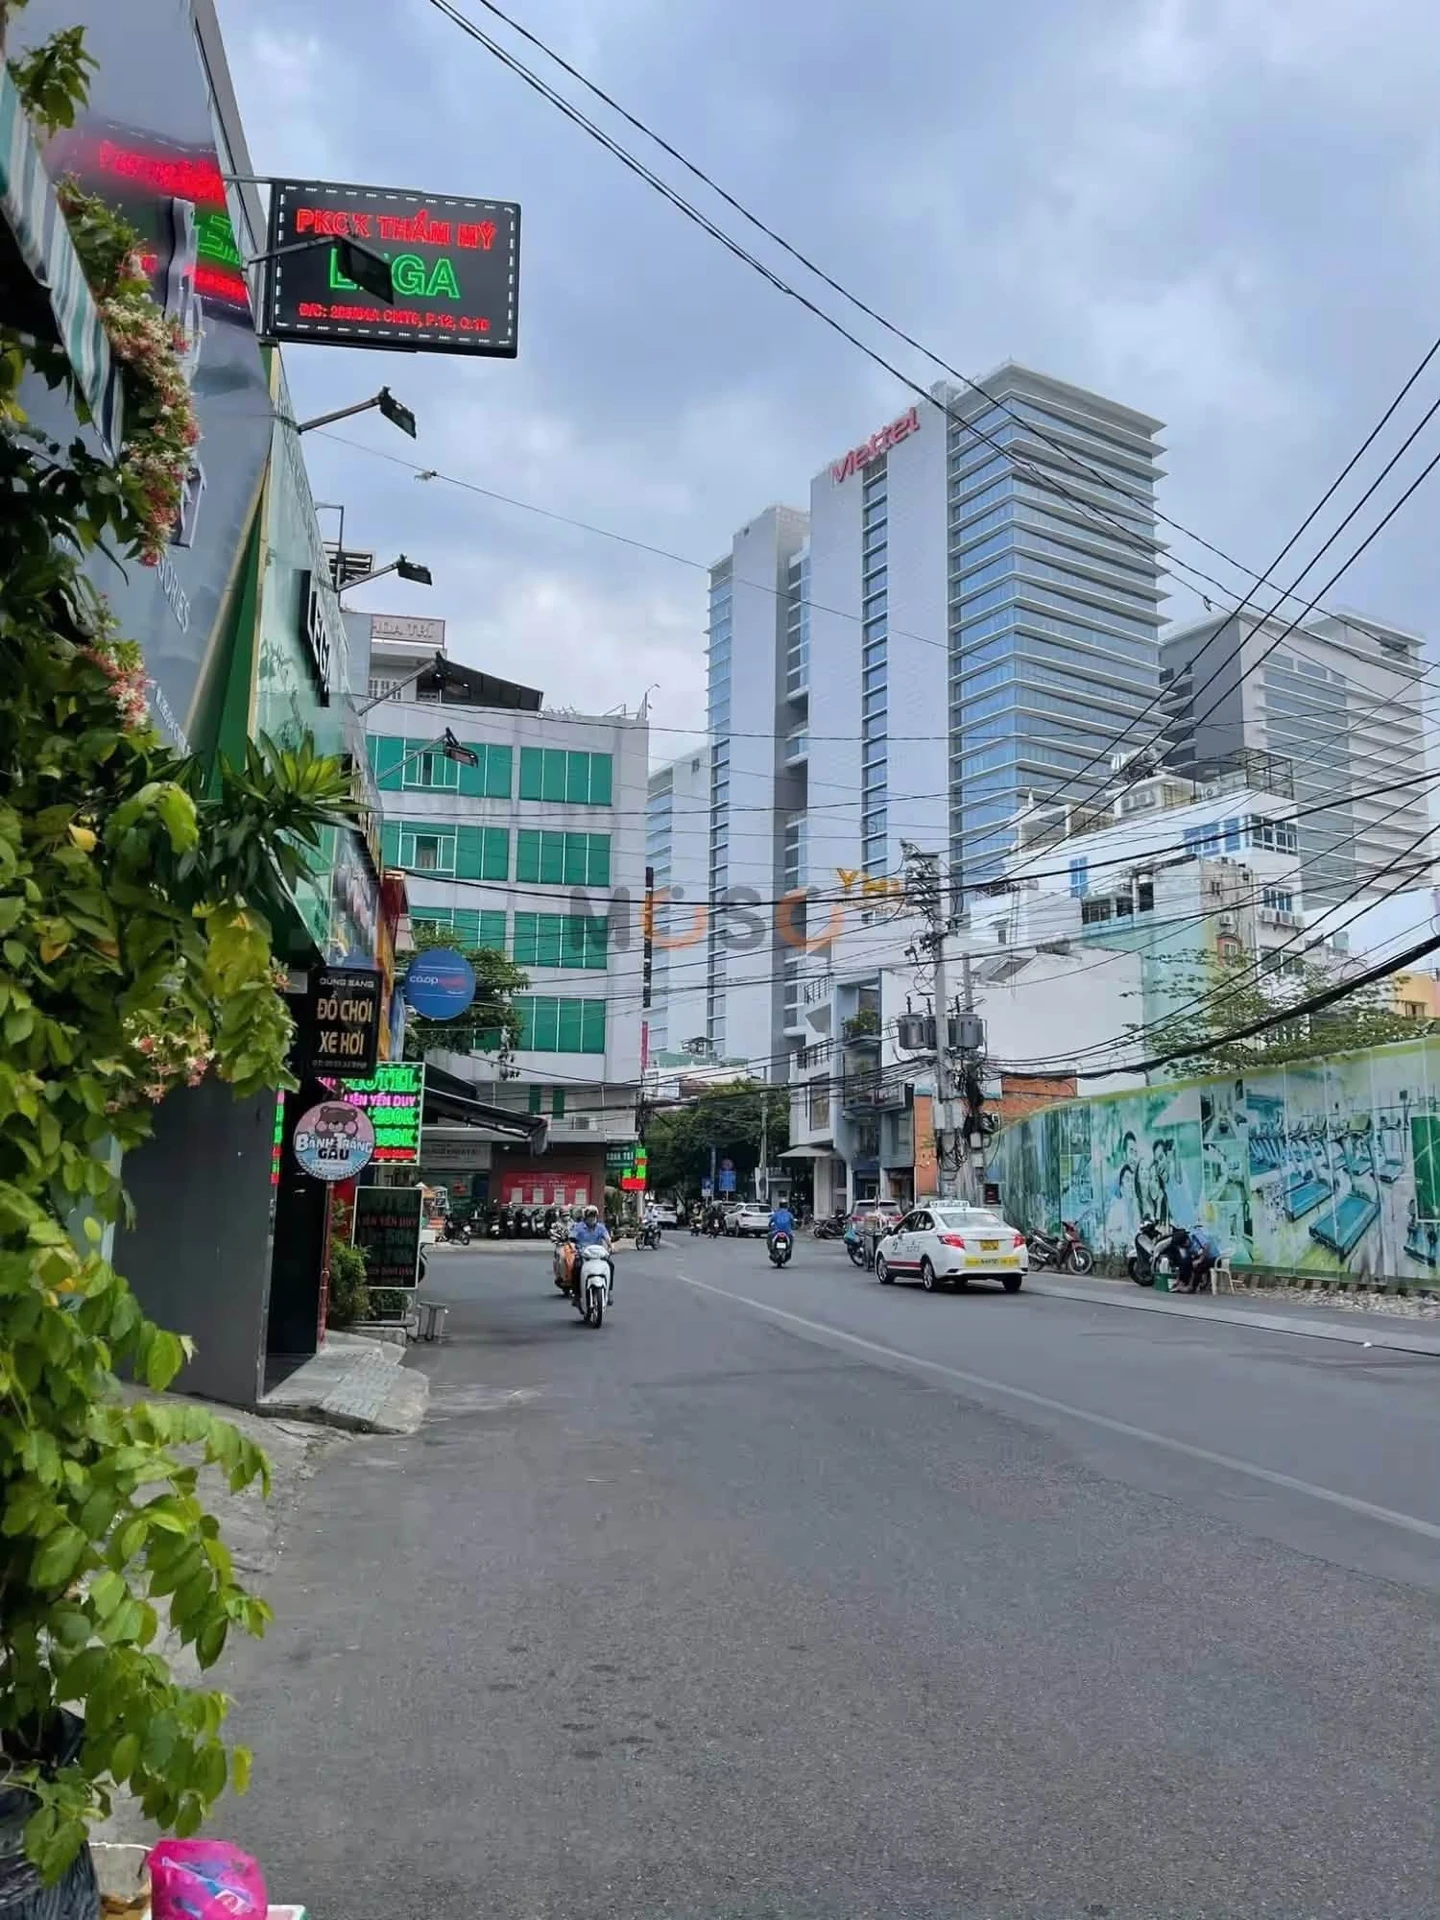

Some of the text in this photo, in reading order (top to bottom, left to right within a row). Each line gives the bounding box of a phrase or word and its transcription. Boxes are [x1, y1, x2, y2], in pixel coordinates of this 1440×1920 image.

[340, 998, 373, 1022] CHƠI
[319, 1030, 365, 1055] XE HƠI
